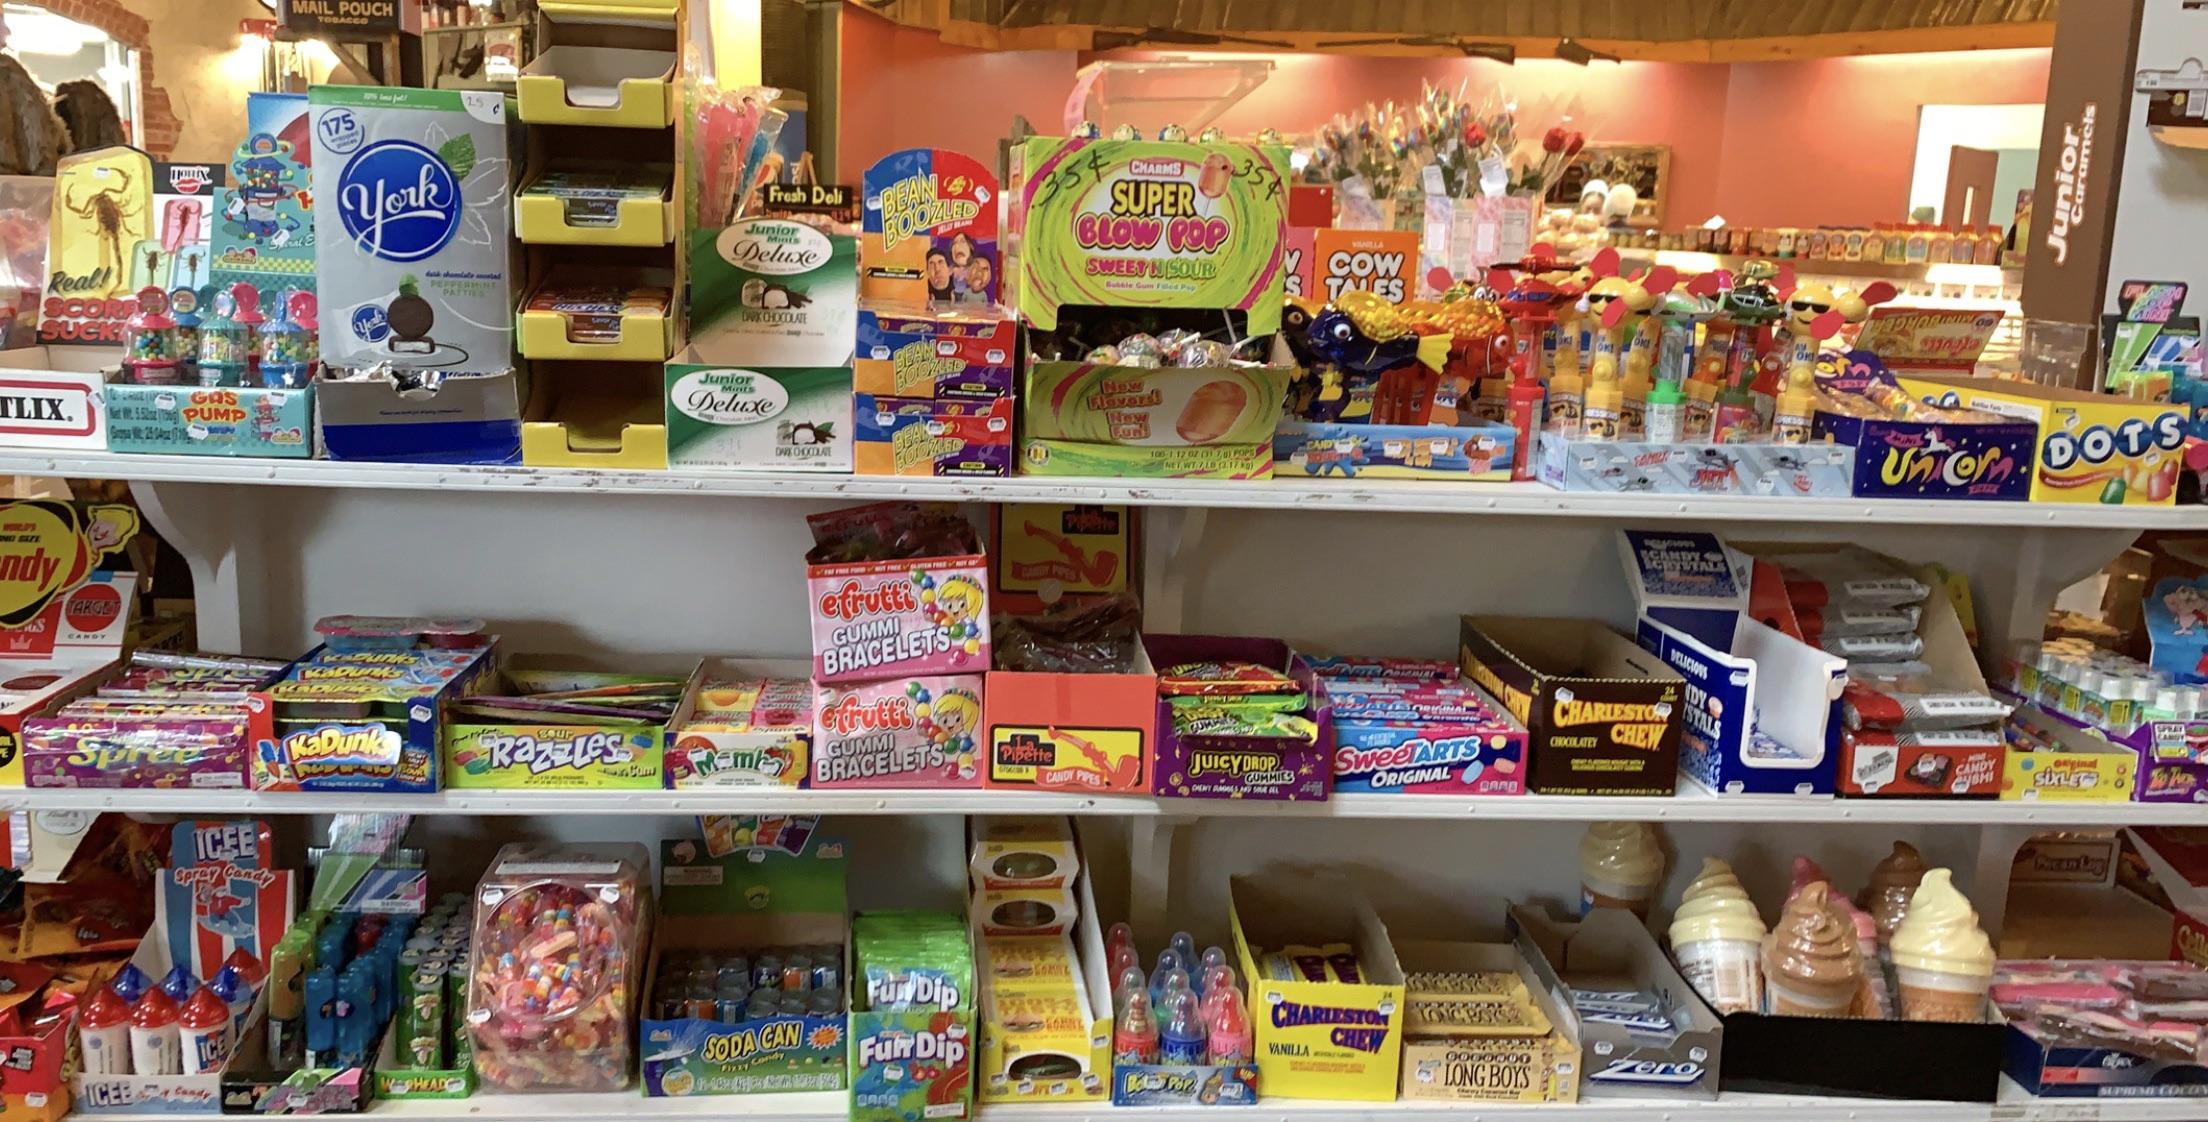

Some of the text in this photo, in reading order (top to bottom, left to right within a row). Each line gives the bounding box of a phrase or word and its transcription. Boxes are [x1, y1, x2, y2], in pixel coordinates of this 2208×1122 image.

[293, 0, 394, 17] MAIL POUCH
[317, 15, 369, 25] TOBACCO
[321, 113, 356, 137] 175
[1130, 160, 1182, 177] CHARMS
[2070, 103, 2097, 226] Caramels
[769, 186, 844, 206] Fresh Deli
[881, 167, 938, 221] BEAN
[1110, 178, 1197, 217] SUPER
[2046, 122, 2080, 265] Junior
[341, 162, 454, 258] York
[744, 223, 800, 237] Junior
[883, 199, 980, 252] BOOZLED
[1076, 212, 1230, 254] BLOW POP
[766, 236, 801, 245] Mints
[1352, 240, 1384, 250] VANILLA
[731, 239, 822, 268] Deluxe
[1328, 250, 1405, 278] COW
[48, 266, 114, 294] Real!
[1086, 258, 1217, 280] SWEET N SOUR
[430, 279, 498, 290] PEPPERMINT
[443, 289, 486, 298] PATTIES
[1105, 281, 1135, 290] Bubble
[1136, 282, 1155, 291] Gum
[1156, 282, 1179, 291] Filled
[1324, 276, 1406, 305] TALES
[352, 309, 385, 342] York
[741, 310, 808, 325] DARK CHOCOLATE
[893, 339, 937, 373] BEAN
[698, 372, 755, 385] Junior
[895, 357, 968, 396] BOOZLED
[1101, 379, 1145, 394] New
[189, 390, 238, 406] GAS
[720, 385, 756, 394] Mints
[1088, 389, 1163, 411] Flavors!
[181, 406, 247, 424] PUMP
[687, 389, 777, 417] Deluxe
[1107, 410, 1150, 426] New
[1110, 423, 1151, 440] Fun!
[1892, 434, 1918, 445] MINI
[2049, 416, 2181, 467] DOTS
[775, 446, 832, 457] DARK CHOCOLATE
[893, 437, 966, 475] BOOZLED
[1233, 447, 1256, 458] POPS
[1164, 461, 1181, 471] NET
[1880, 447, 2014, 487] Unicorn
[819, 578, 918, 621] efrutti
[67, 633, 107, 641] CANDY
[831, 616, 901, 647] GUMMI
[823, 626, 951, 678] BRACELETS
[1670, 648, 1709, 681] DELICIOUS
[1664, 685, 1675, 695] 24
[819, 691, 914, 736] efrutti
[1412, 704, 1467, 714] ORIGINAL
[1504, 684, 1533, 727] CHEW
[827, 732, 896, 759] GUMMI
[1015, 735, 1035, 751] La
[1550, 736, 1599, 748] CHOCOLATEY
[1610, 723, 1669, 750] CHEW
[66, 734, 203, 772] Spree
[491, 732, 625, 776] Razzles
[816, 743, 945, 783] BRACELETS
[999, 744, 1054, 764] Pipette
[1189, 751, 1278, 777] JUICY DROP
[1335, 735, 1482, 776] SweeTARTS
[628, 764, 657, 779] Gum
[1370, 765, 1452, 789] ORIGINAL
[1955, 759, 1997, 777] CANDY
[2053, 758, 2099, 773] original
[1045, 769, 1101, 787] CANDY PIPES
[1191, 783, 1212, 793] CHEWY
[1245, 771, 1295, 785] GUMMIES
[194, 823, 258, 861] ICEE
[174, 863, 276, 889] Spray Candy
[2034, 854, 2106, 876] Pecan Log
[867, 974, 961, 1012] Fun Dip
[1383, 991, 1393, 1000] 24
[1271, 1000, 1390, 1029] CHARLESTON
[702, 1020, 805, 1064] SODA CAN
[858, 1030, 966, 1070] Fun Dip
[1268, 1042, 1310, 1057] VANILLA
[1330, 1026, 1390, 1055] CHEW
[719, 1051, 786, 1073] Fizzy Candy
[1445, 1051, 1532, 1065] COCONUT
[1444, 1061, 1531, 1089] LONG BOYS
[1588, 1057, 1706, 1084] Zero
[85, 1080, 212, 1107] ICEE Candy
[2100, 1086, 2156, 1097] SUPREME
